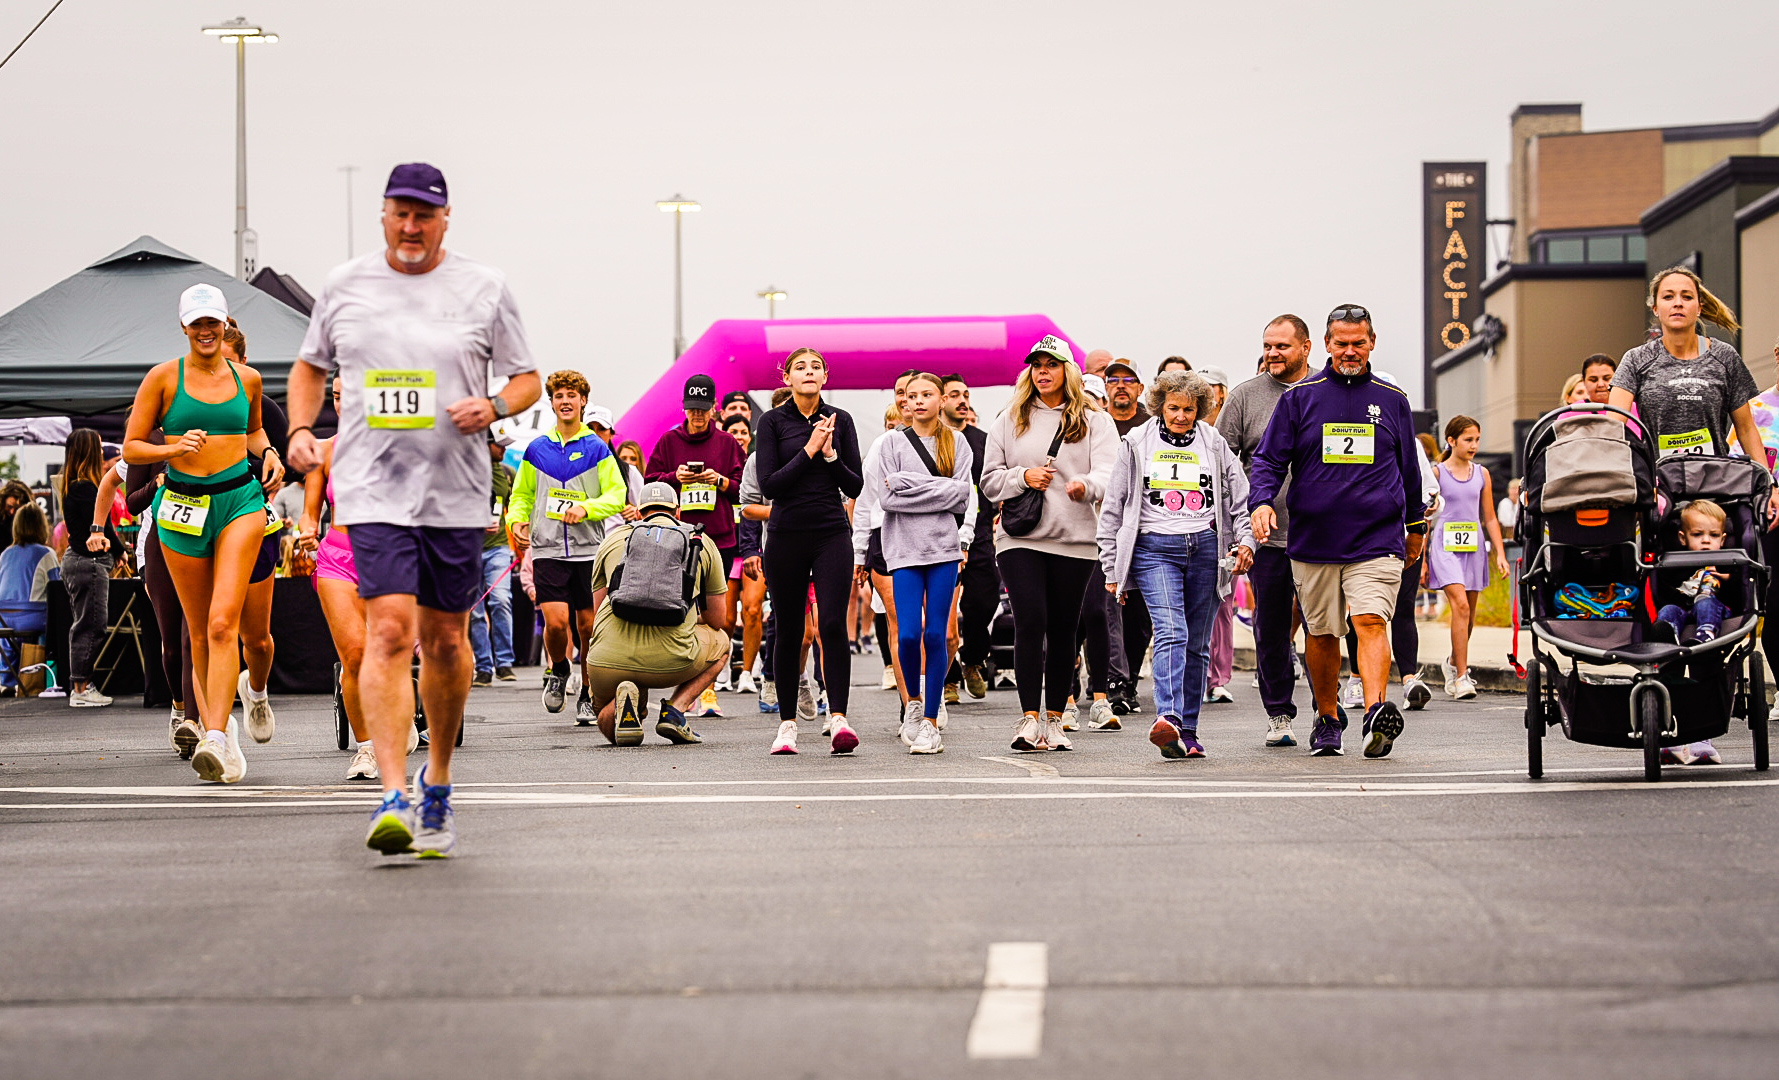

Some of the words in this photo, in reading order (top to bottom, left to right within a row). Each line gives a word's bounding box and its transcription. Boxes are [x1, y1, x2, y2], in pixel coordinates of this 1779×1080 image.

[1444, 172, 1466, 188] THE
[688, 386, 708, 397] OPG
[378, 390, 420, 414] 119
[1343, 436, 1354, 455] 2
[1667, 437, 1690, 446] DONUT
[1690, 434, 1704, 442] RUN
[1170, 463, 1179, 481] 1
[688, 491, 710, 504] 114
[171, 503, 194, 524] 75
[1454, 532, 1470, 545] 92
